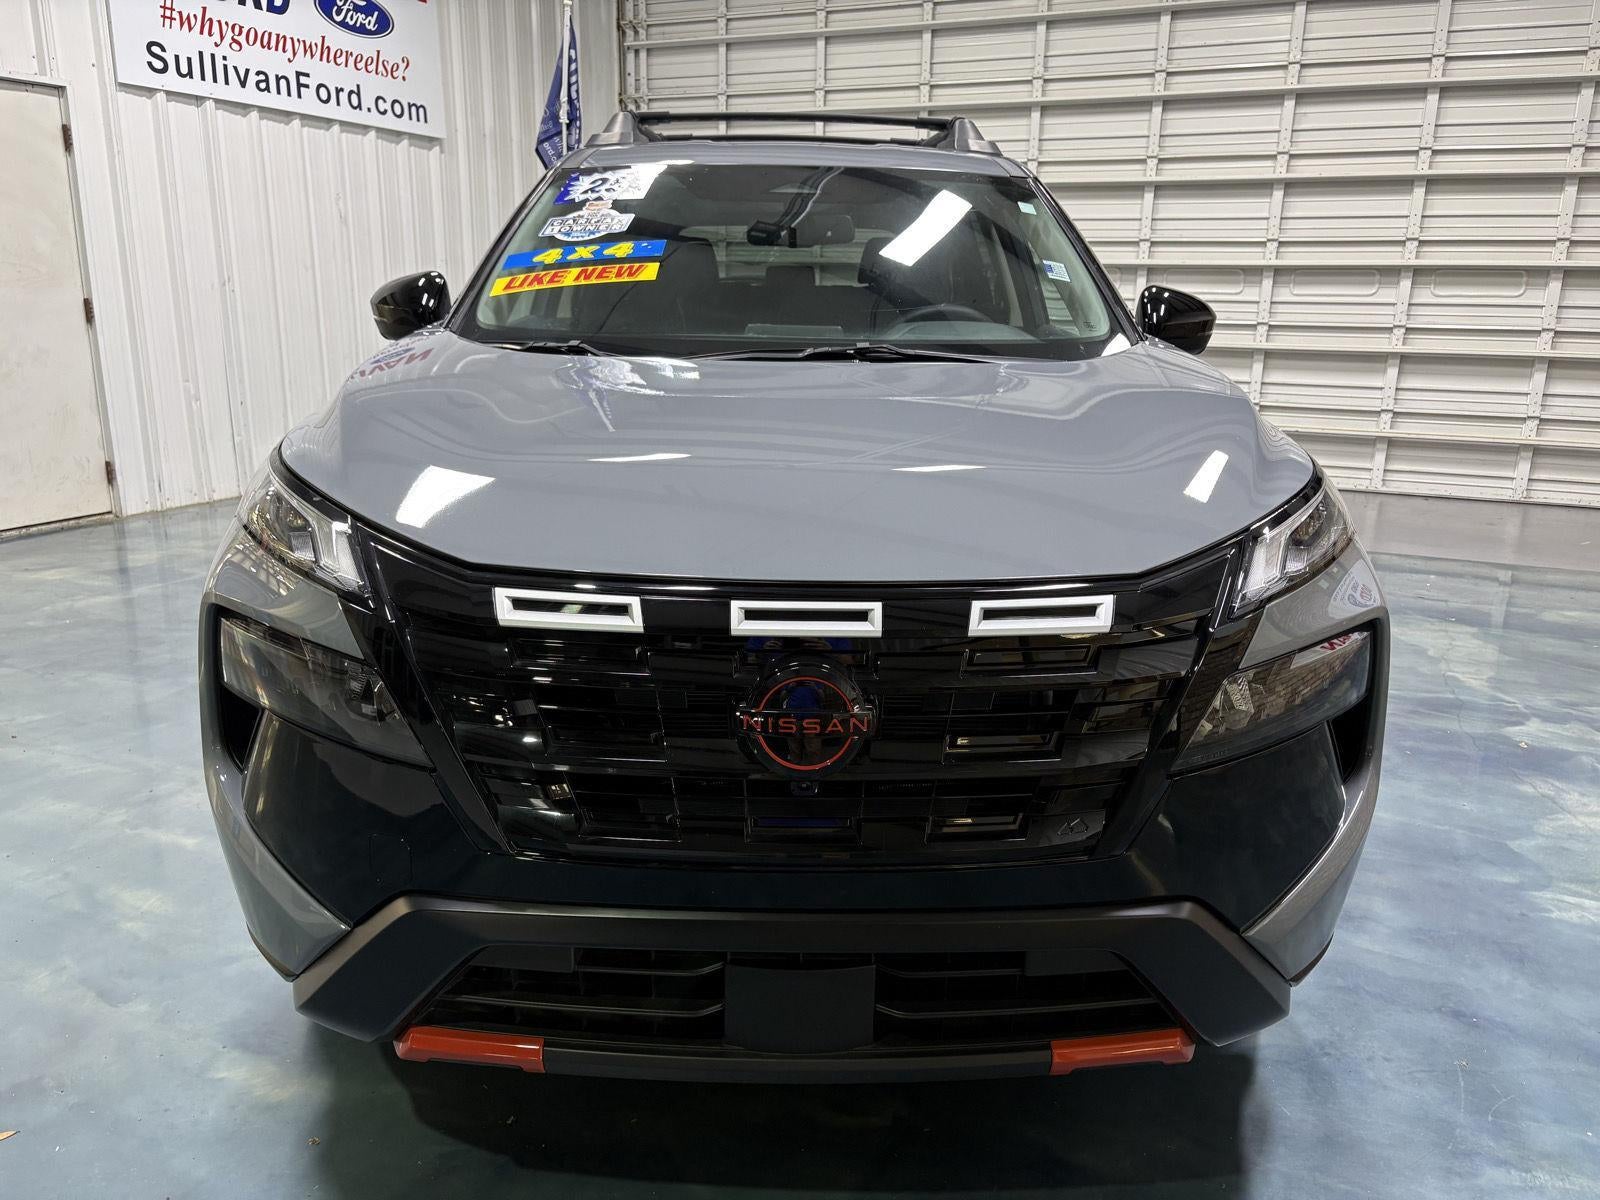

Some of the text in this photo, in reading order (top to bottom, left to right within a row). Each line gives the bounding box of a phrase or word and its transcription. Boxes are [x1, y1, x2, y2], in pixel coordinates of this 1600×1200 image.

[331, 0, 379, 31] Ford
[159, 0, 410, 82] #whygoanywhereelse?
[146, 40, 428, 123] SullivanFord.com
[502, 263, 648, 292] LIKE NEW
[741, 713, 869, 734] NISSAN
